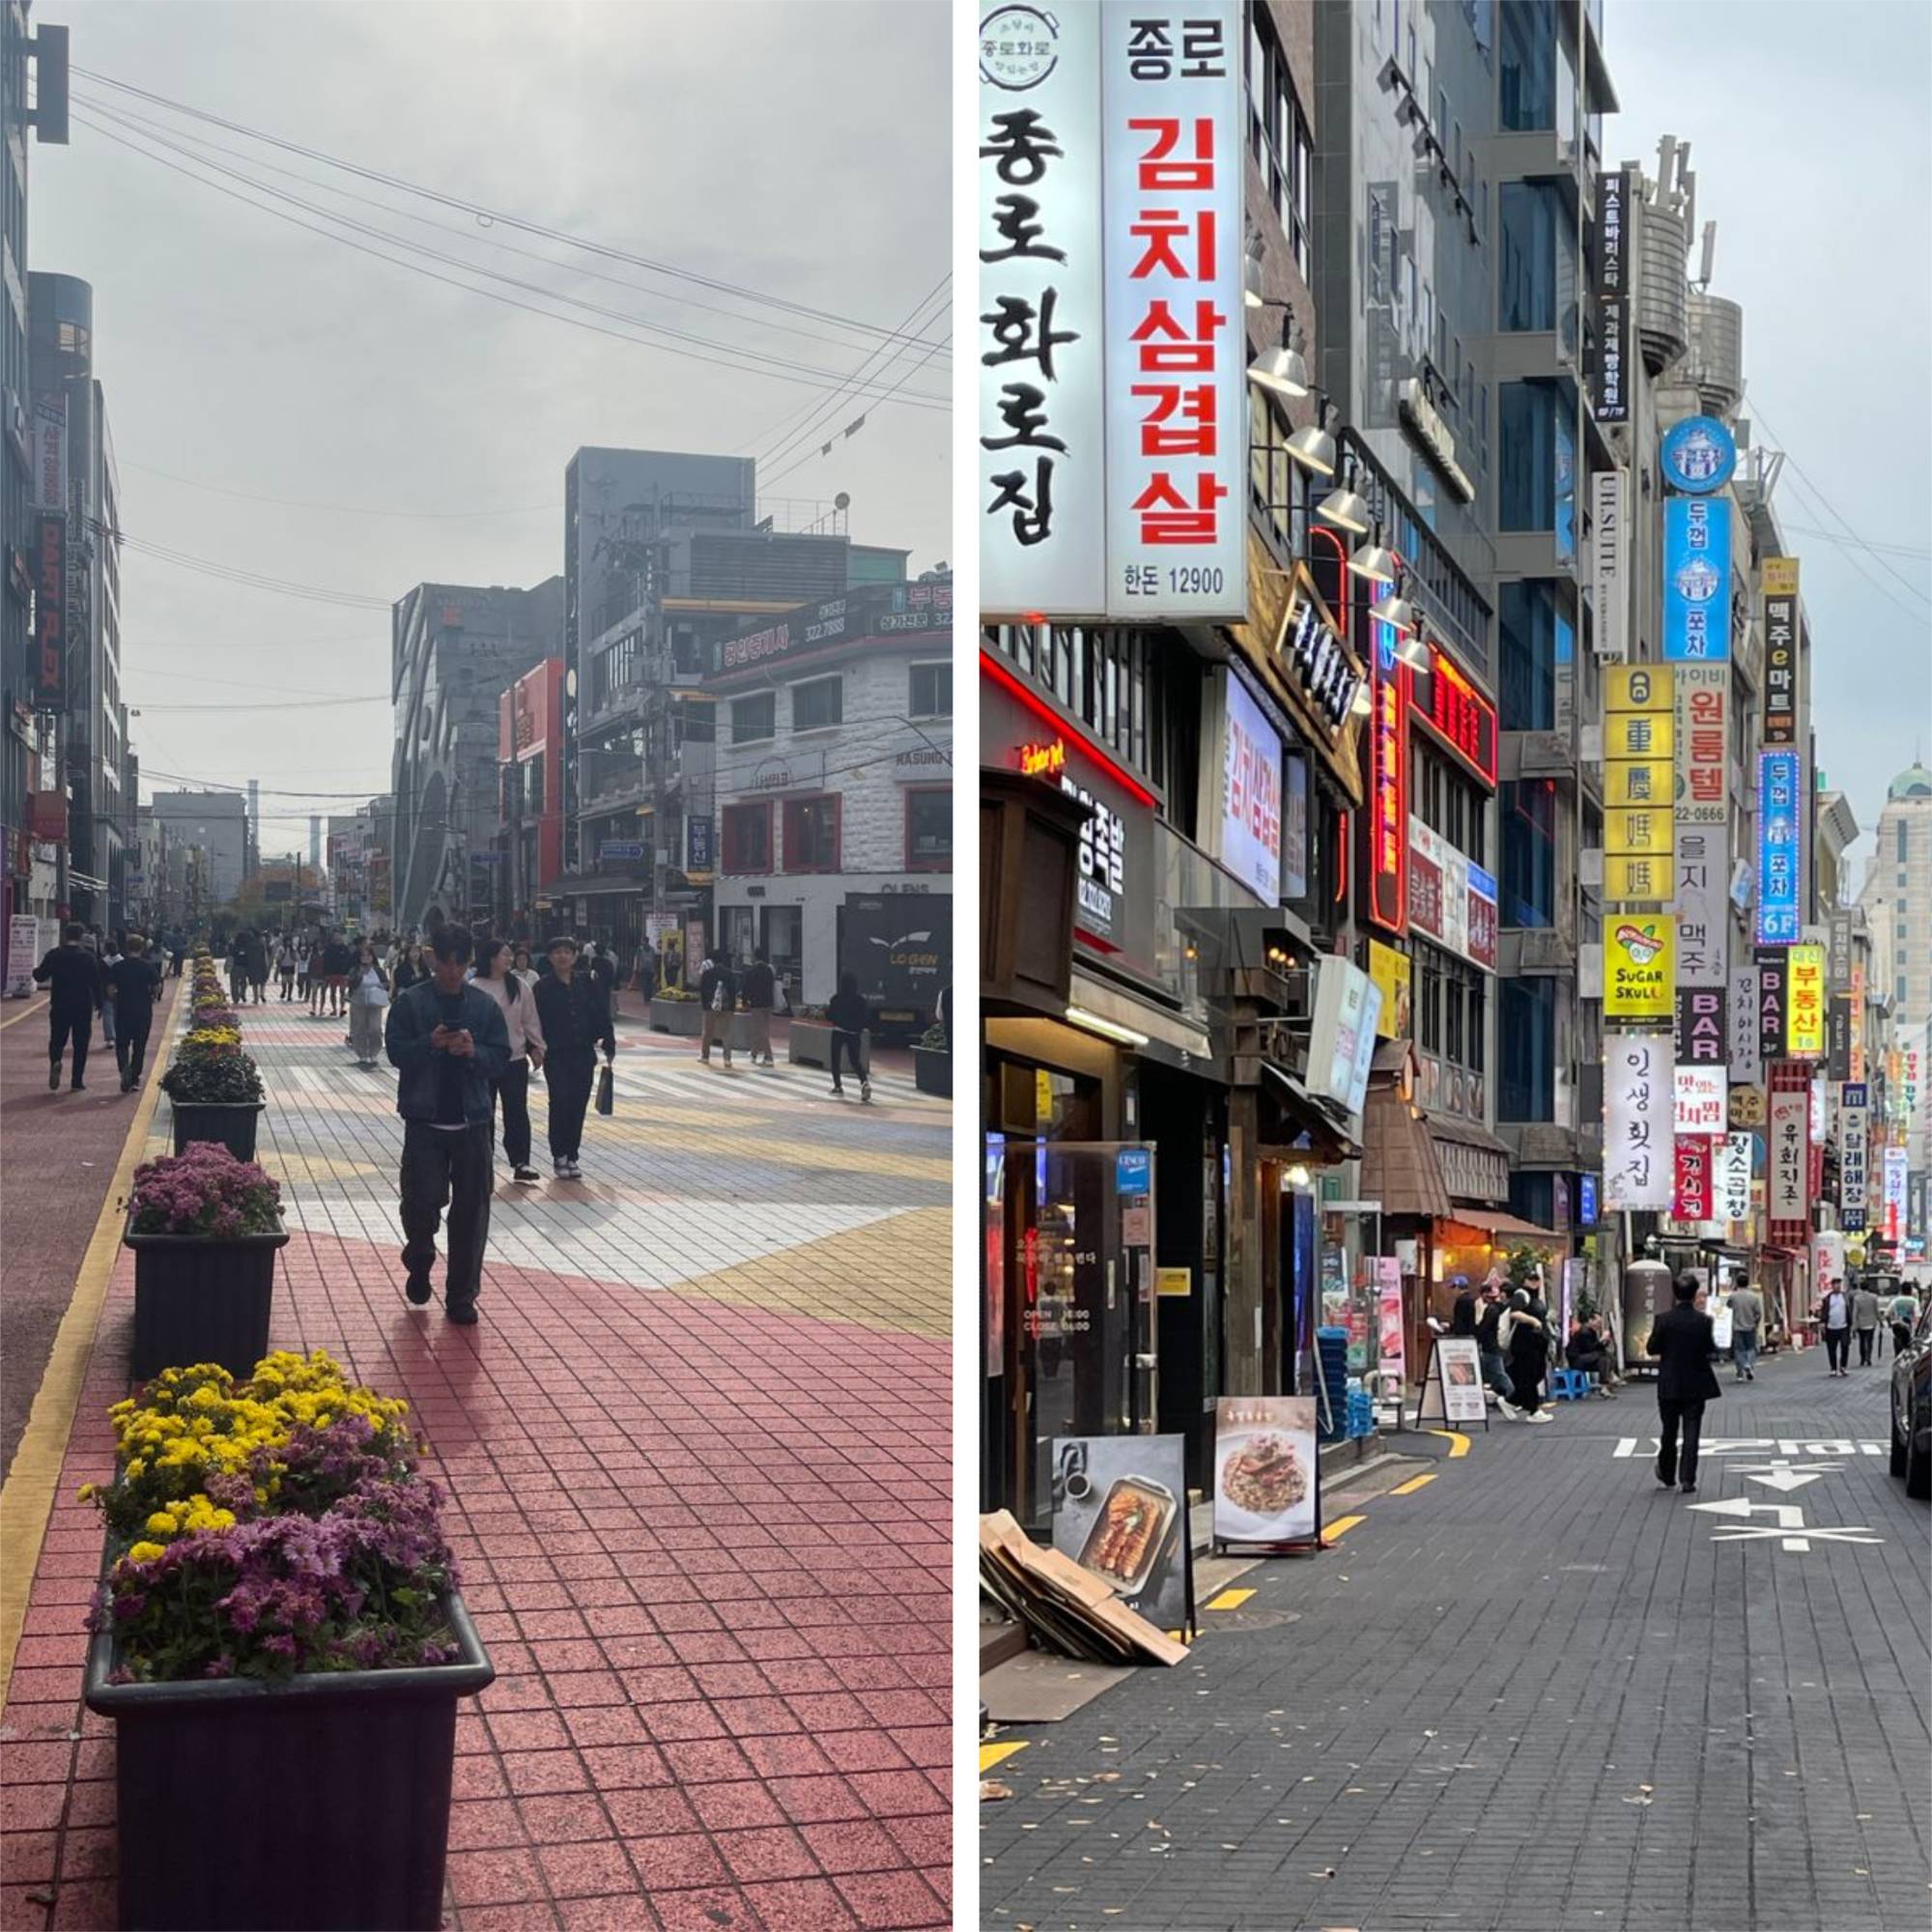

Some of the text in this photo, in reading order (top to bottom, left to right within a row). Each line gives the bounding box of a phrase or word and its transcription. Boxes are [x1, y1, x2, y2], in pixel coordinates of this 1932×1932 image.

[1127, 19, 1226, 81] 종로
[1127, 118, 1228, 545] 김치삼겹살
[1600, 476, 1616, 578] UH.SUITE
[1124, 565, 1224, 595] 한돈 12900
[1687, 501, 1709, 657] 두껍 포차
[724, 623, 789, 668] 공인중개사
[1689, 691, 1724, 802] 원룸텔
[694, 825, 706, 864] 부동산
[1772, 764, 1788, 896] 두껍 포차
[1679, 835, 1708, 975] 을지 맥주
[1764, 910, 1794, 934] 6F
[890, 952, 939, 965] LOGEN
[1616, 968, 1663, 982] SUGAR
[1616, 985, 1661, 1000] SKULL
[1762, 972, 1781, 1034] BAR
[1794, 966, 1819, 1034] 부동산
[1690, 994, 1719, 1059] BAR
[1627, 1047, 1652, 1187] 인생횟집
[1726, 1135, 1749, 1217] 황소곱창
[1780, 1123, 1800, 1207] 육회지존
[1023, 1310, 1052, 1320] OPEN
[1023, 1321, 1058, 1332] CLOSE
